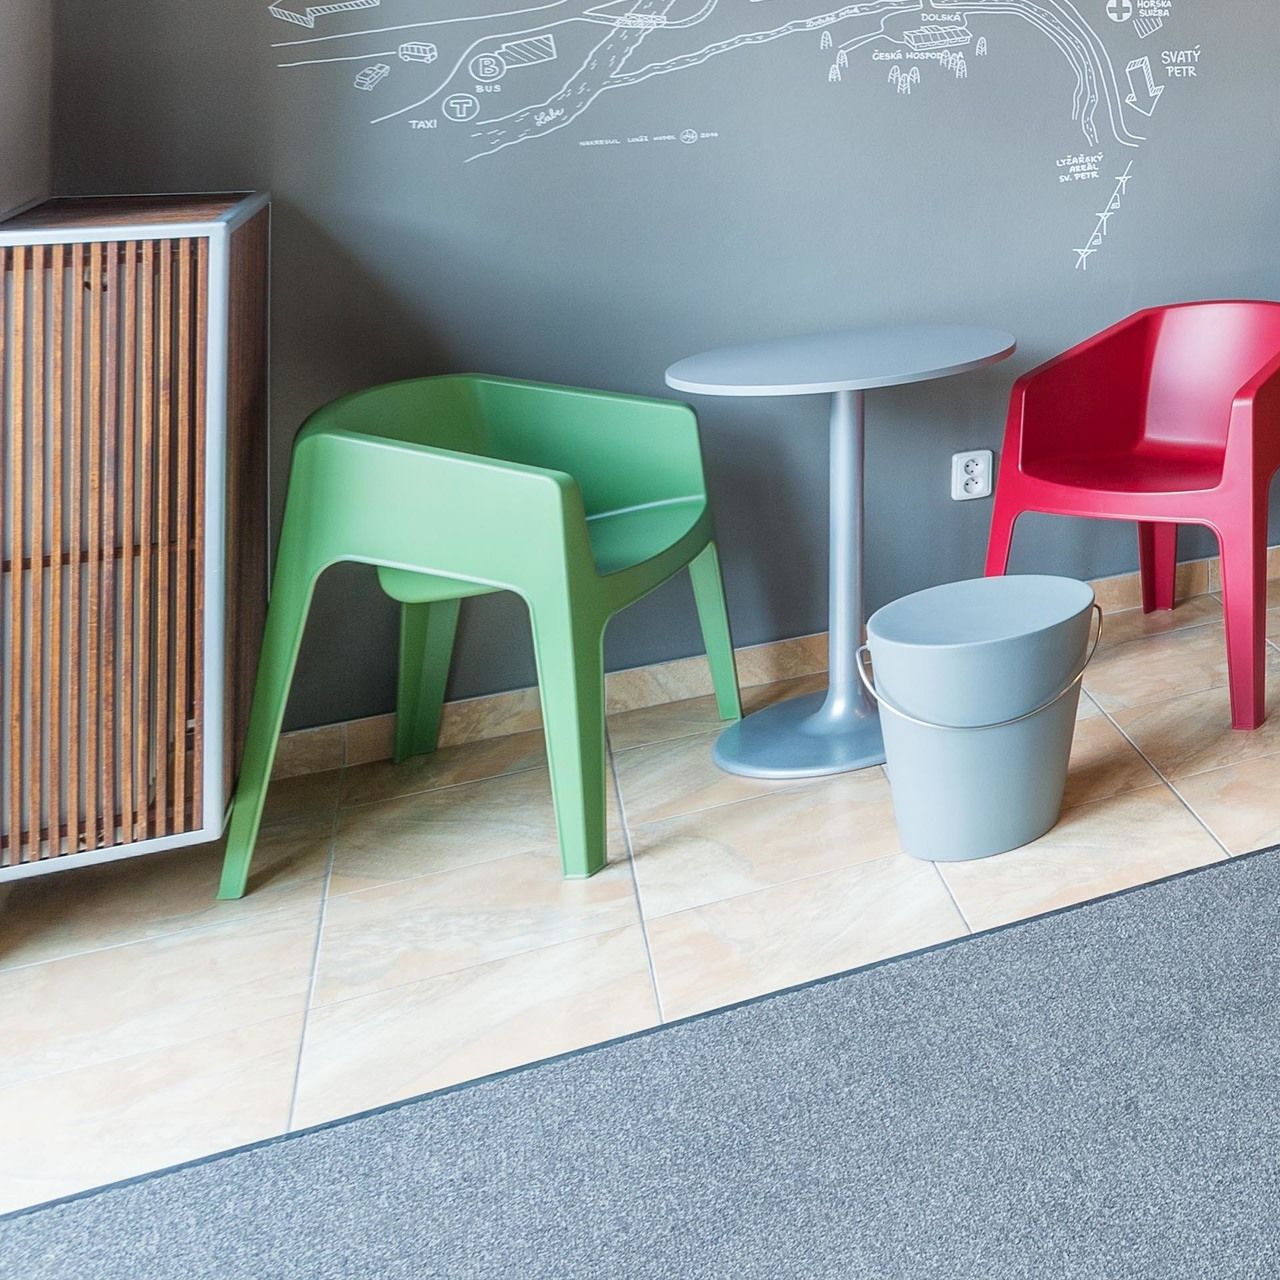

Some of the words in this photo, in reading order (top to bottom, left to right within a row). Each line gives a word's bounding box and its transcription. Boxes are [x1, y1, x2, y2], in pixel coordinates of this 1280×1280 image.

[921, 12, 962, 22] DOLSKÁ
[1161, 44, 1201, 64] SVATÝ
[1165, 66, 1198, 77] PETR
[475, 84, 502, 93] BUS
[408, 120, 438, 129] TAXI
[1074, 171, 1100, 180] PETR
